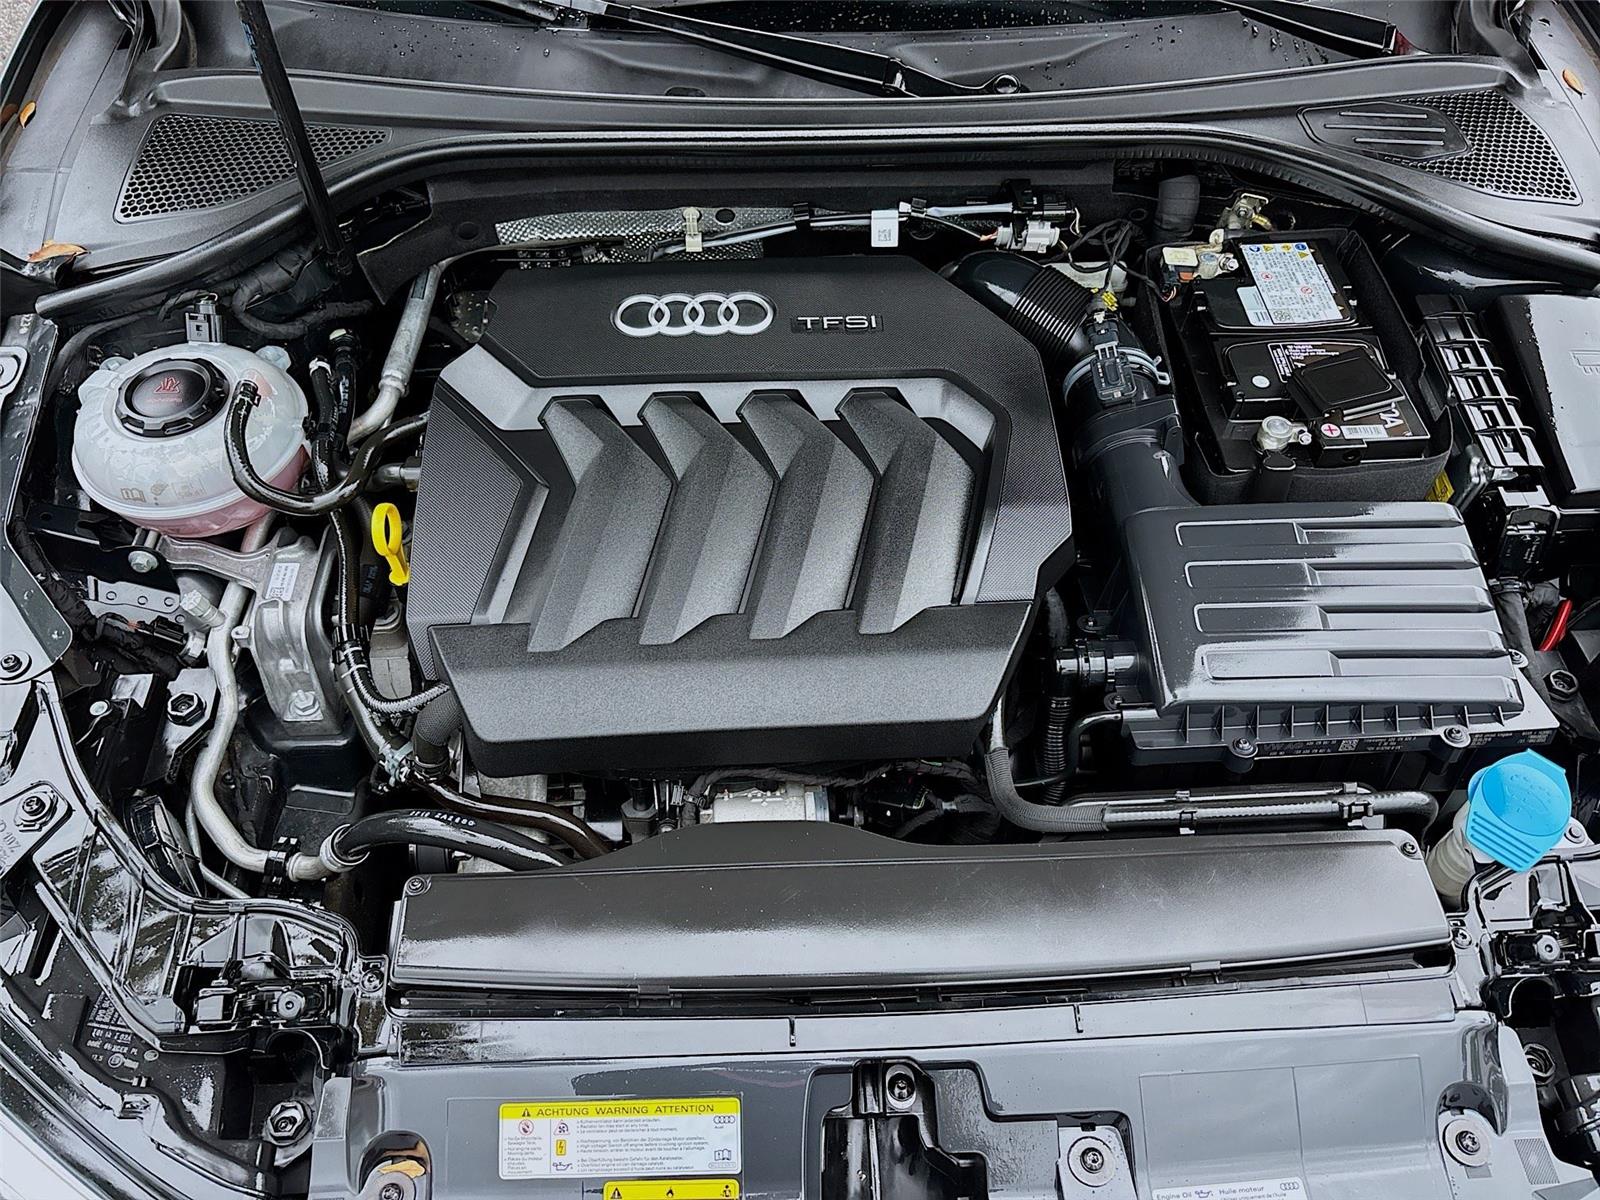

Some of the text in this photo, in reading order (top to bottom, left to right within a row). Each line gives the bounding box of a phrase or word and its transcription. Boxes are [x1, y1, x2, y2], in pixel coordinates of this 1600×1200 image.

[797, 314, 878, 331] TFSI
[536, 1104, 715, 1116] ACHTUNG WARNING ATTENTION
[1219, 1186, 1264, 1195] Huile moteur
[1156, 1192, 1181, 1200] Engine
